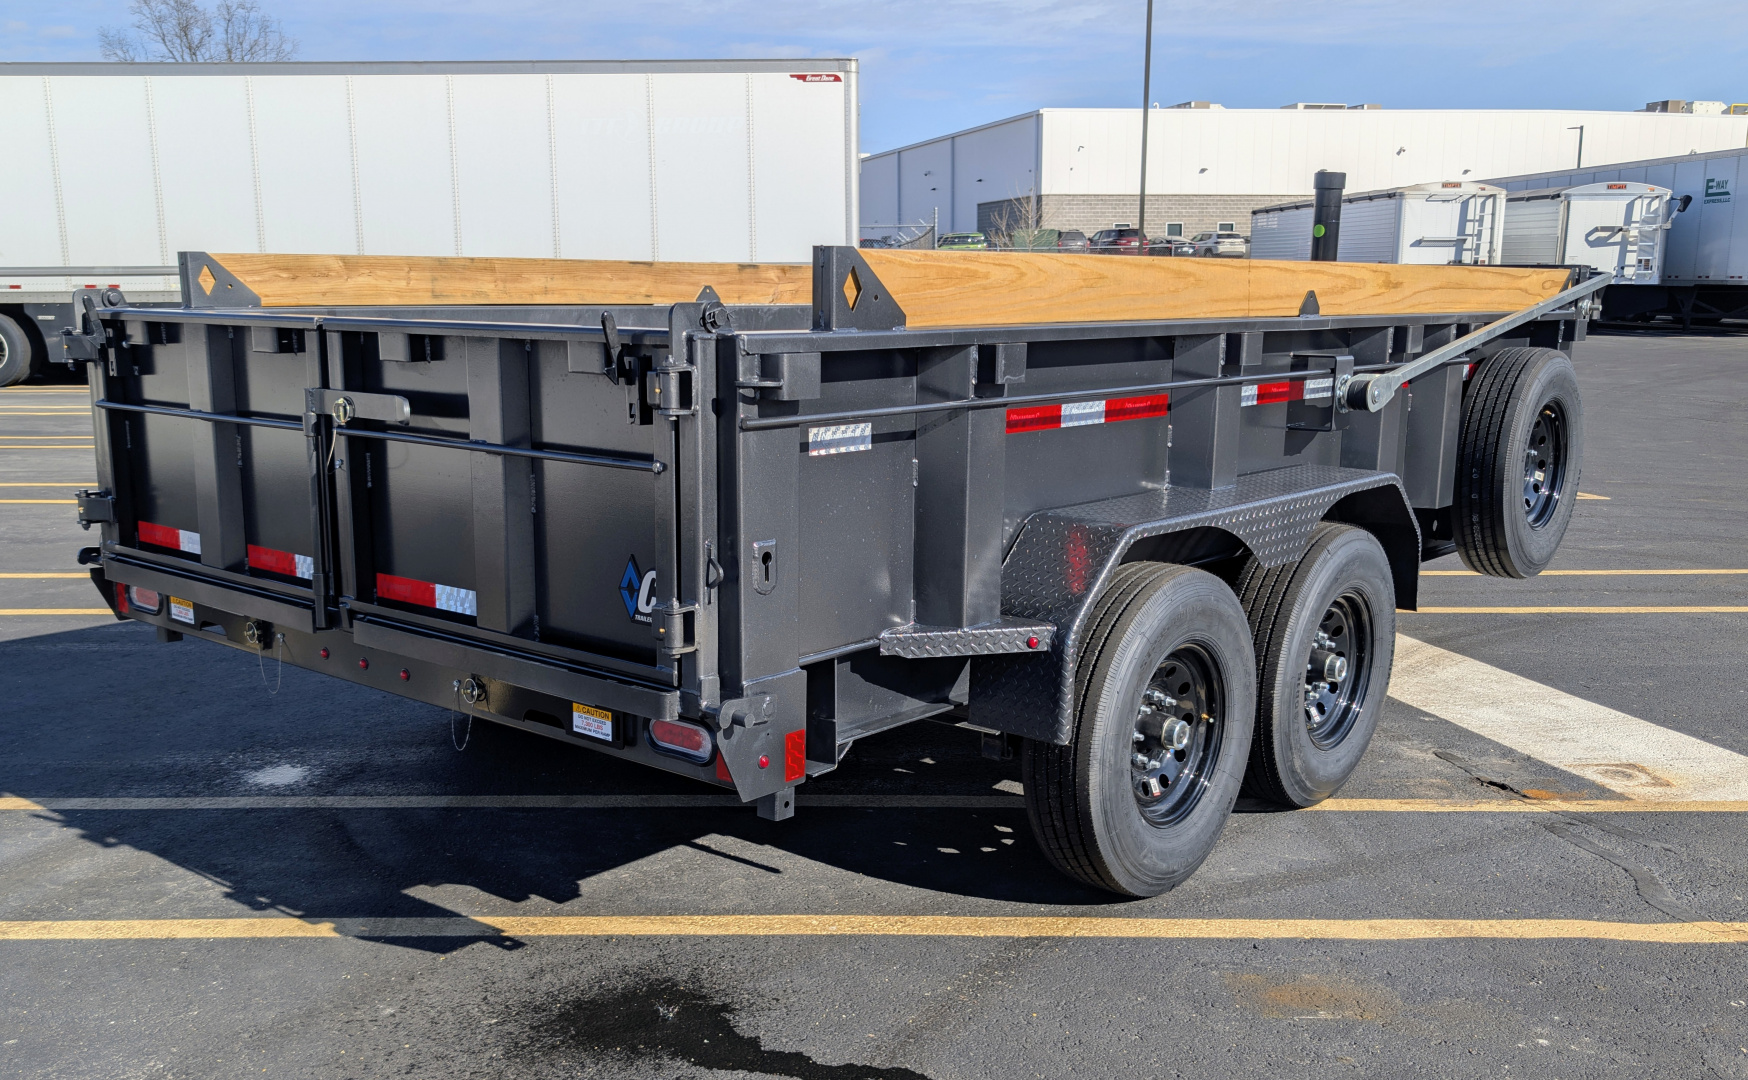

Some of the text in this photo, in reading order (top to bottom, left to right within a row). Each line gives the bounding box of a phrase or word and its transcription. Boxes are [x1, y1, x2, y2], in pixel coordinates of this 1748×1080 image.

[805, 74, 835, 82] Great Dane
[1705, 178, 1730, 197] E-WAY
[582, 707, 609, 719] CAUTION
